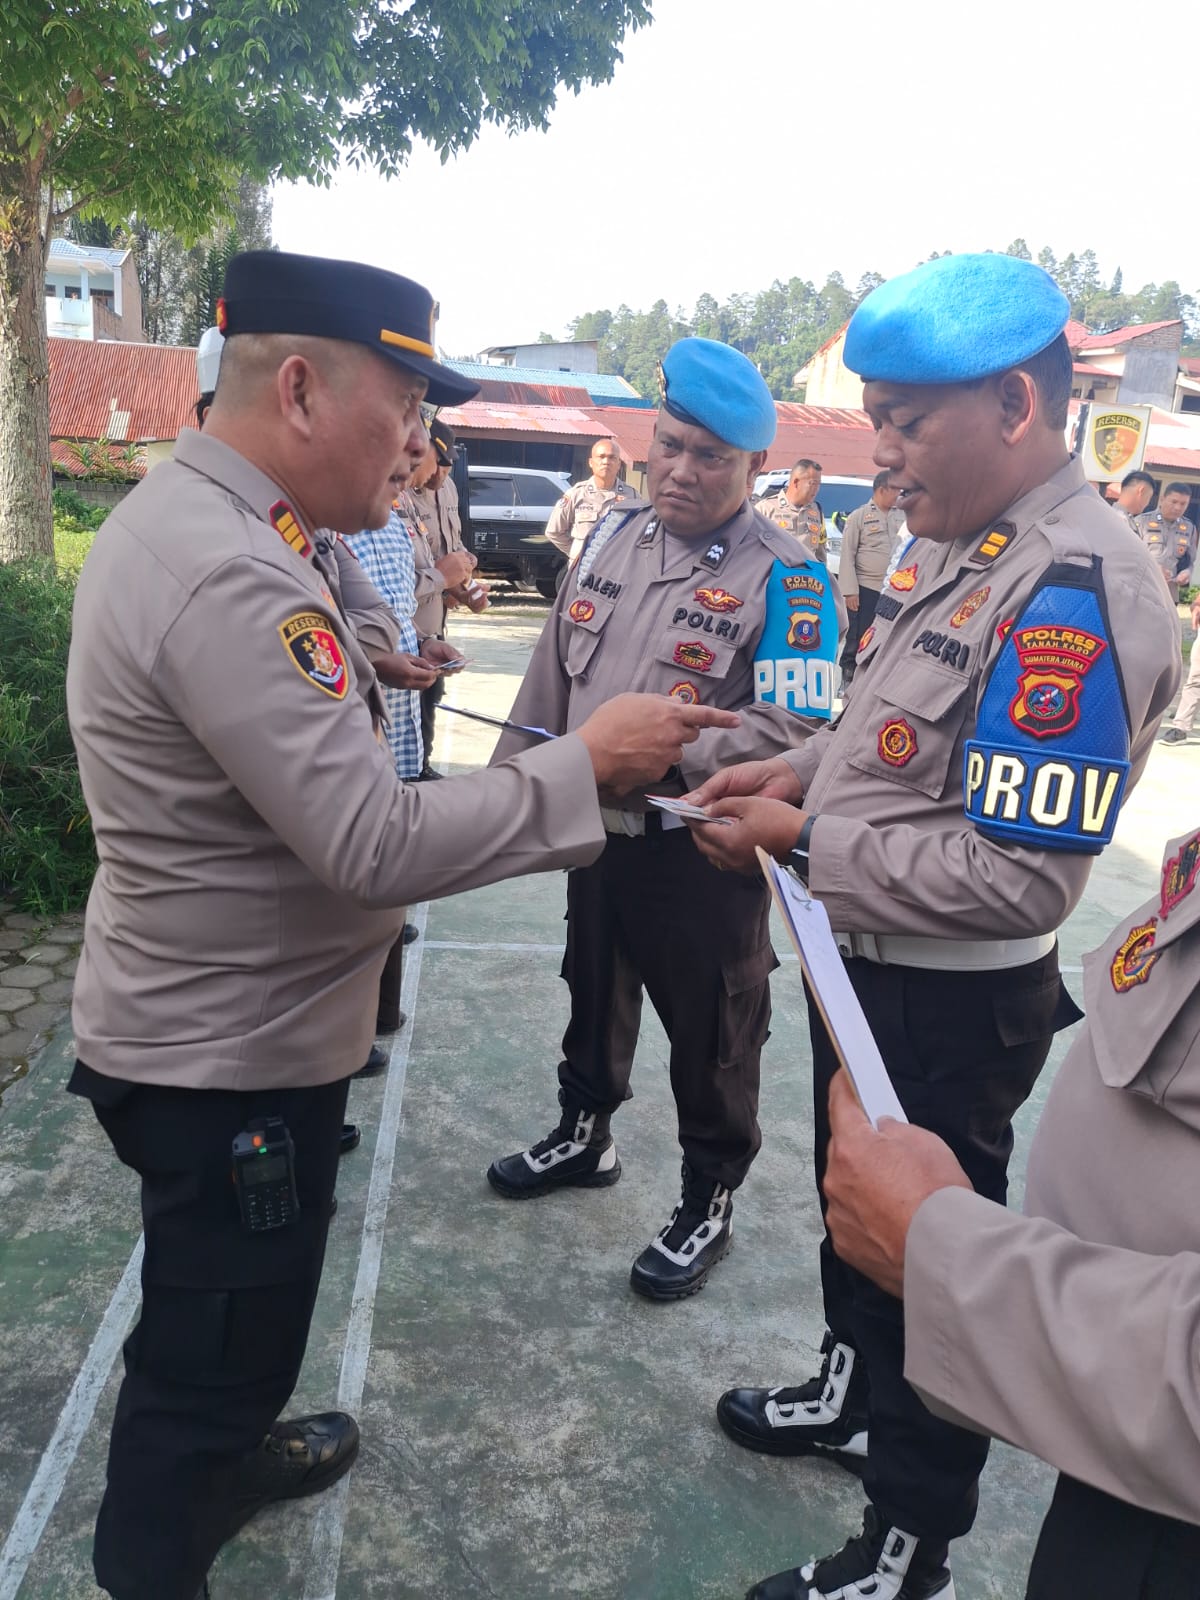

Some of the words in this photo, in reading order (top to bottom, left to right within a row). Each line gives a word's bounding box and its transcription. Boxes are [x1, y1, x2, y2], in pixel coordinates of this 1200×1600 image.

[672, 607, 741, 640] POLRI
[912, 629, 971, 670] POLRI
[1022, 629, 1097, 651] POLRES
[1027, 640, 1059, 649] TANAH
[1062, 642, 1090, 656] KARO
[1024, 655, 1060, 664] SUMATERA
[1060, 657, 1085, 671] UTARA
[967, 750, 1121, 834] PROV
